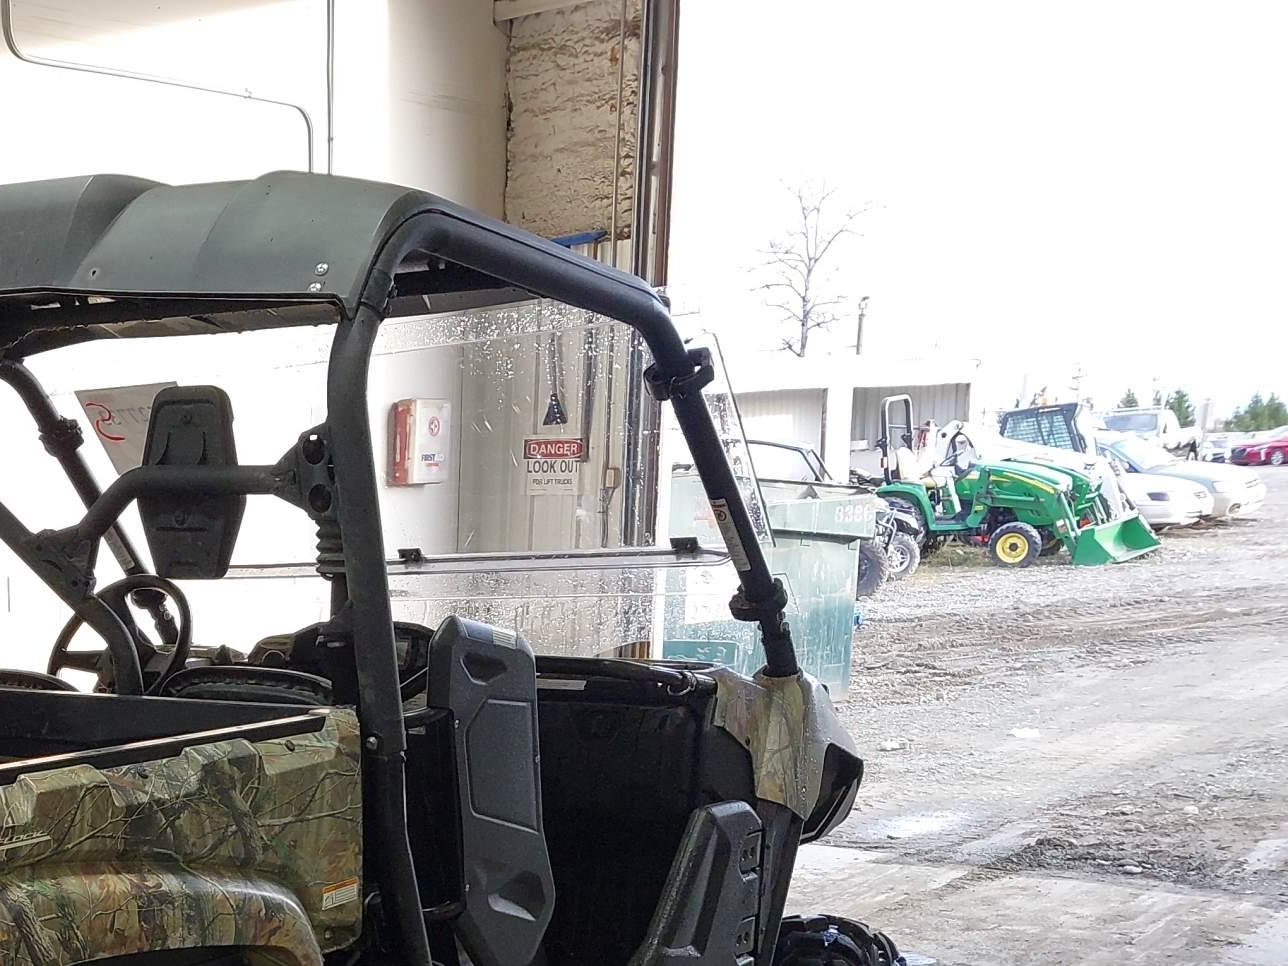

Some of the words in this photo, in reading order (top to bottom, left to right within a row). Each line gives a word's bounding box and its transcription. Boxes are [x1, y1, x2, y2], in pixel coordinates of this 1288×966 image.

[530, 443, 578, 456] DANGER
[527, 460, 556, 474] LOOK
[560, 460, 581, 474] OUT
